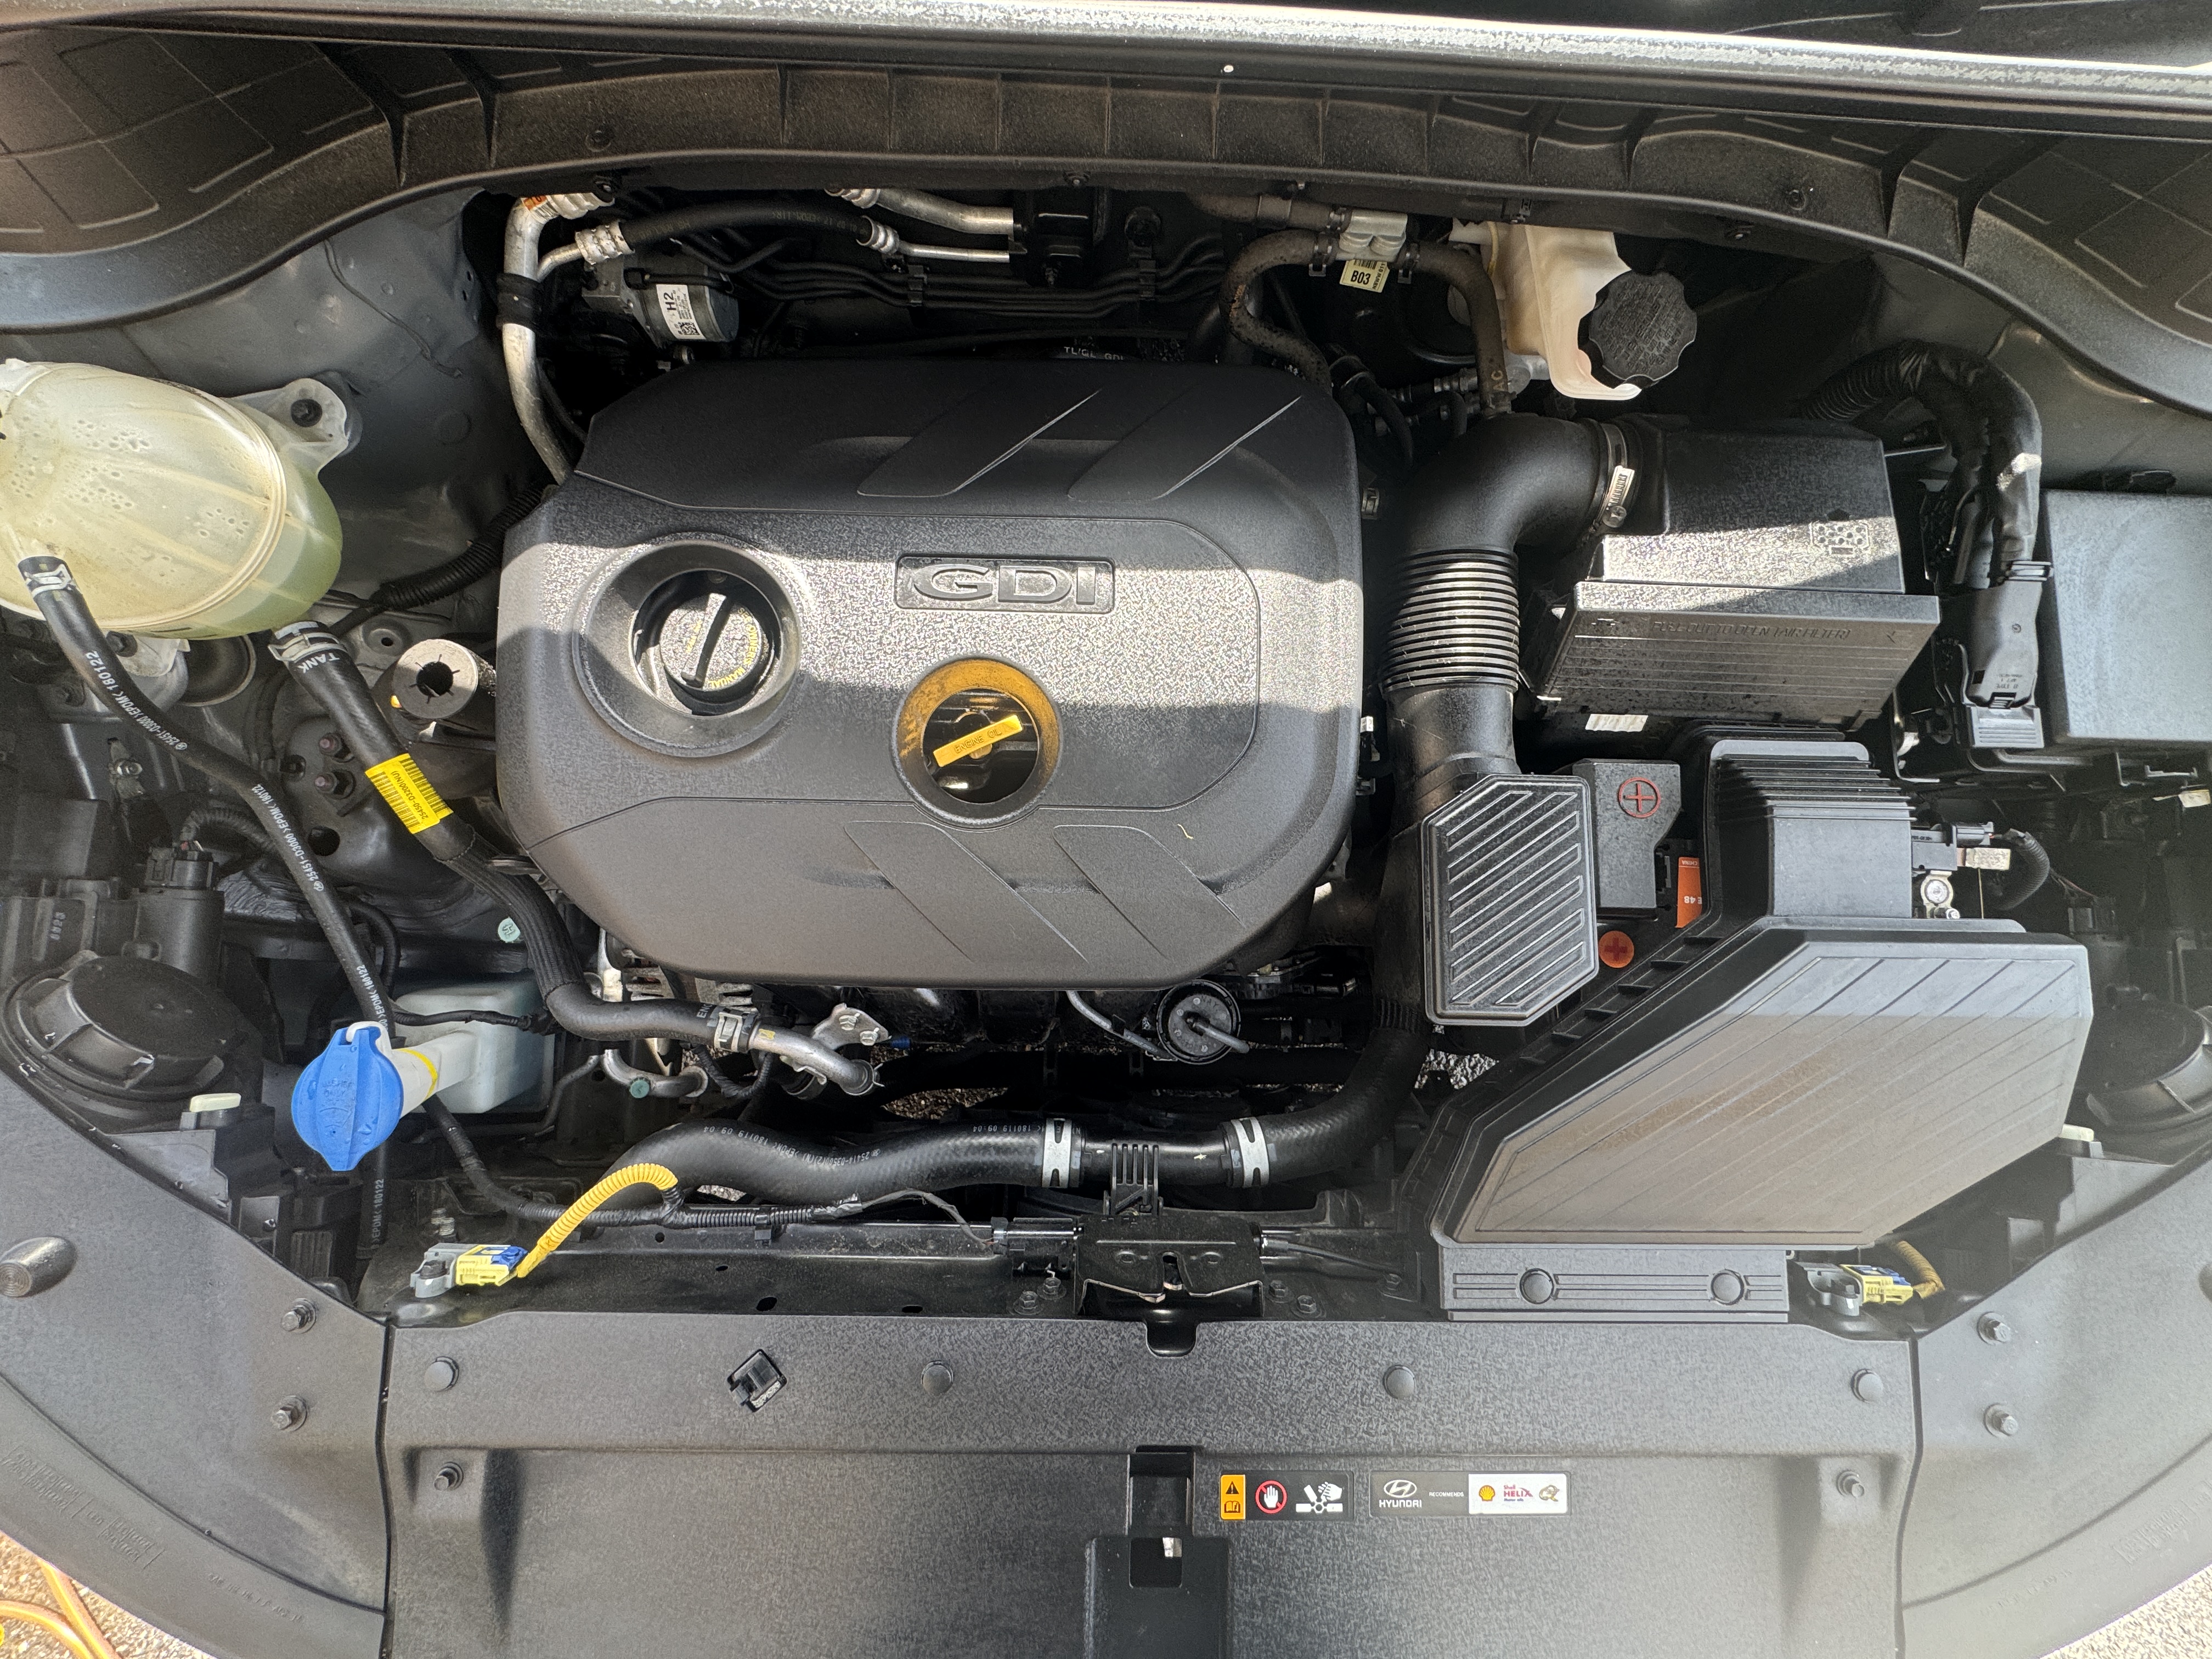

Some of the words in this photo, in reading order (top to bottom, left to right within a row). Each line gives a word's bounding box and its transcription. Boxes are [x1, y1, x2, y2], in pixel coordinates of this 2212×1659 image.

[1351, 270, 1372, 285] B03
[663, 292, 678, 311] H2
[913, 563, 1098, 605] GDI
[737, 607, 753, 624] SEE
[1716, 623, 1734, 634] TO
[1735, 624, 1770, 636] OPEN
[85, 650, 119, 691] 180122
[297, 652, 341, 674] TANK
[707, 666, 746, 689] MANUAL
[954, 735, 985, 754] ENGINE
[988, 729, 1003, 739] OIL
[251, 783, 274, 804] 180122
[1684, 896, 1696, 905] 48
[356, 964, 375, 991] 180122
[737, 1129, 768, 1146] 180119
[374, 1178, 385, 1209] 180122
[1503, 1488, 1534, 1498] HELIX
[1379, 1499, 1423, 1508] HYUNDAI
